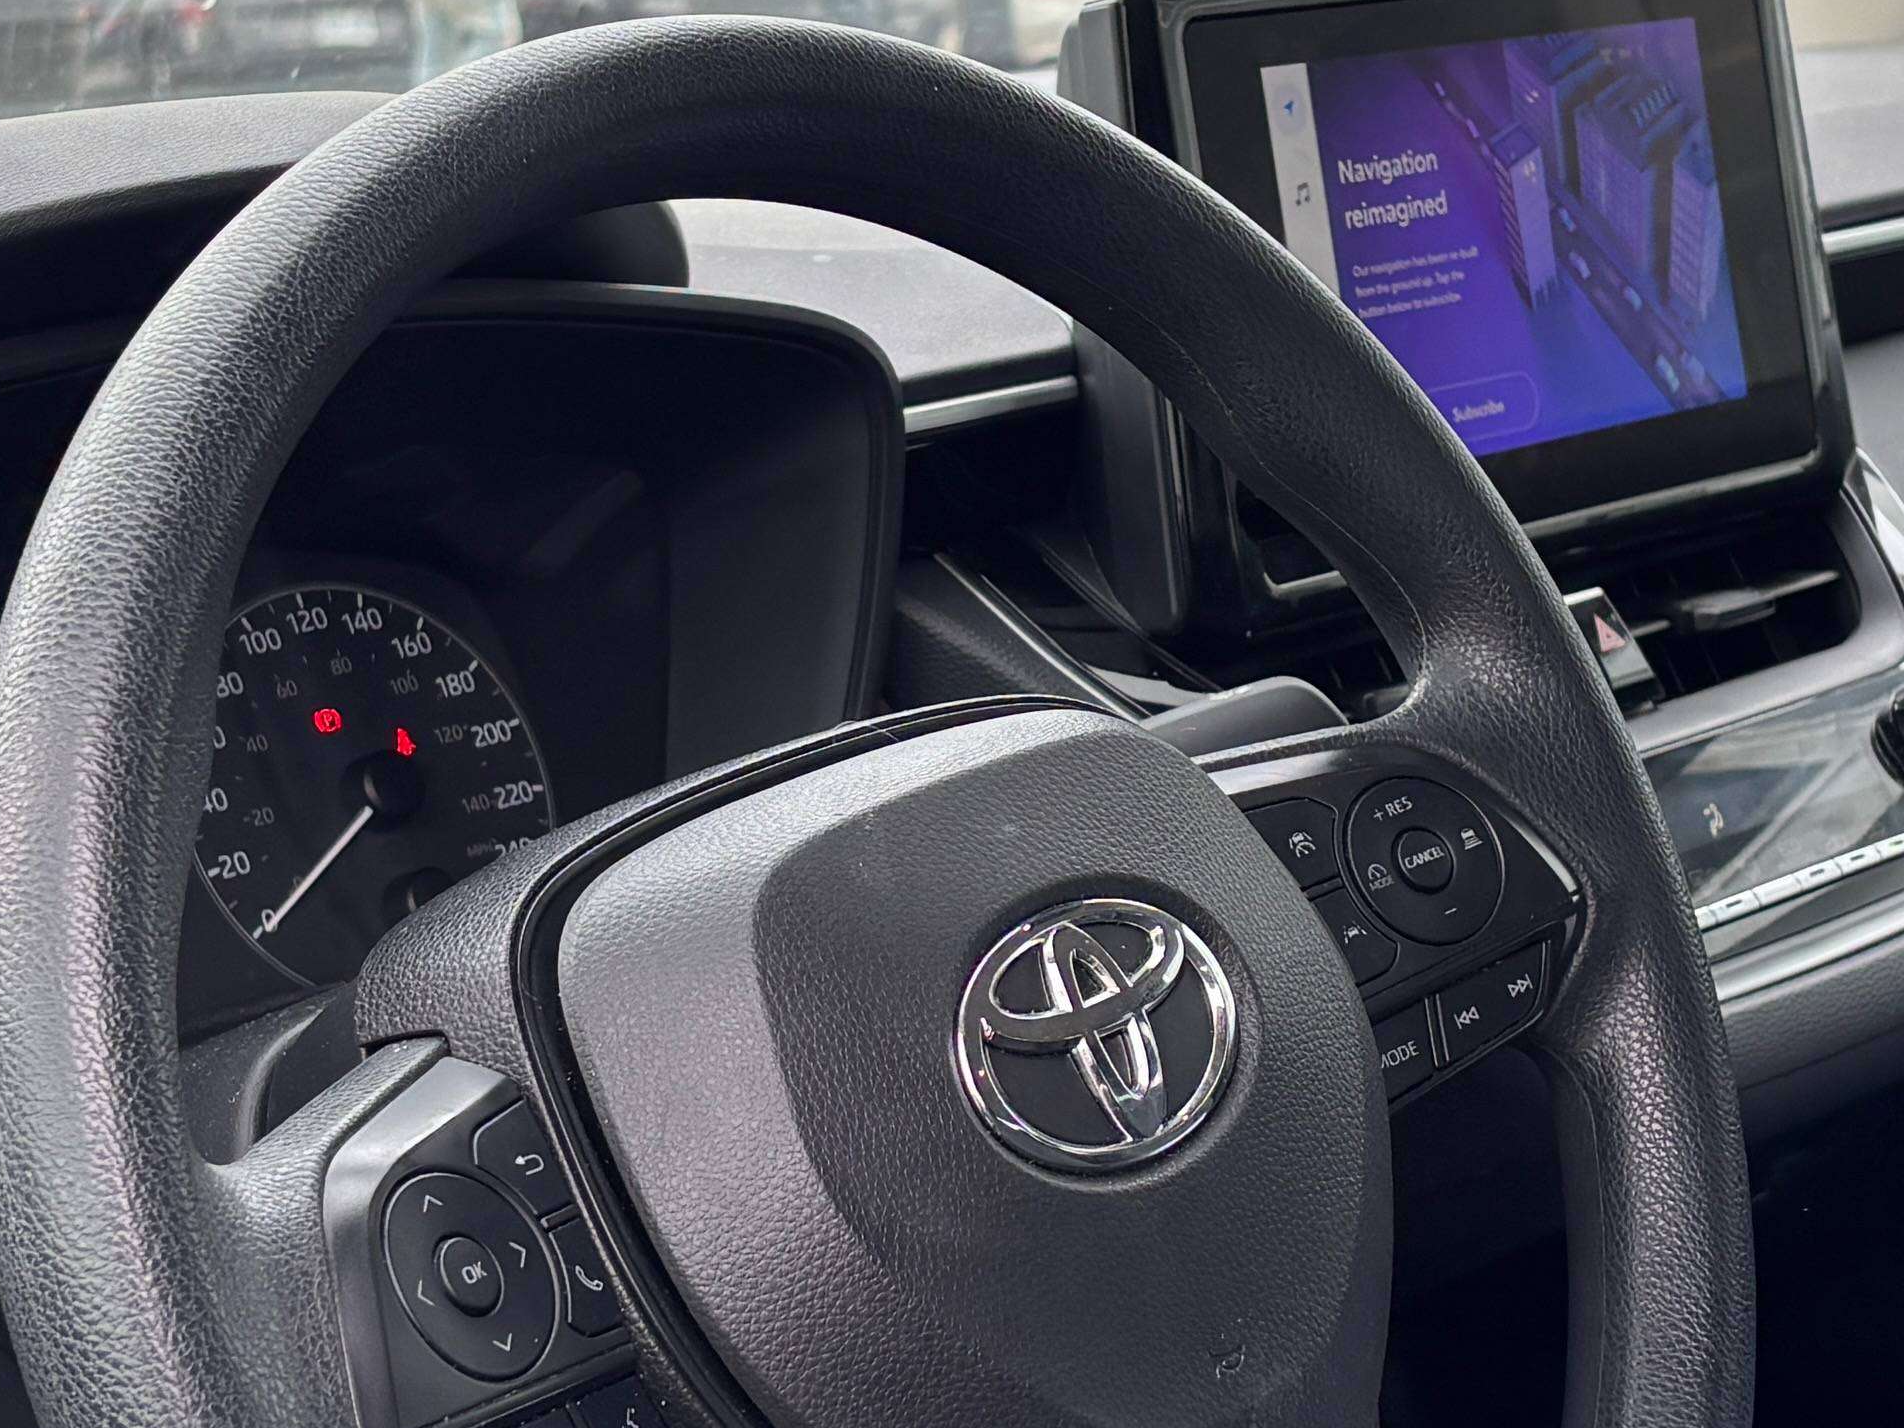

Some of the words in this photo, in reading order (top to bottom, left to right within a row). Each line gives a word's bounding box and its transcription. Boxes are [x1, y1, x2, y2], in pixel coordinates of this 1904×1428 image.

[1337, 149, 1439, 185] Navigation
[1345, 189, 1447, 229] reimagined
[286, 606, 328, 635] 120
[341, 607, 383, 635] 140
[239, 627, 282, 655] 100
[391, 631, 432, 659] 160
[330, 656, 353, 676] 80
[216, 671, 244, 699] 80
[276, 679, 298, 700] 60
[435, 670, 475, 698] 180
[246, 733, 268, 753] 40
[434, 724, 464, 744] 120
[470, 720, 512, 748] 200
[493, 780, 534, 810] 220
[1385, 795, 1413, 817] RES
[252, 806, 275, 827] 20
[218, 851, 251, 879] 20
[1404, 846, 1445, 869] CANCEL
[461, 1261, 488, 1284] OK
